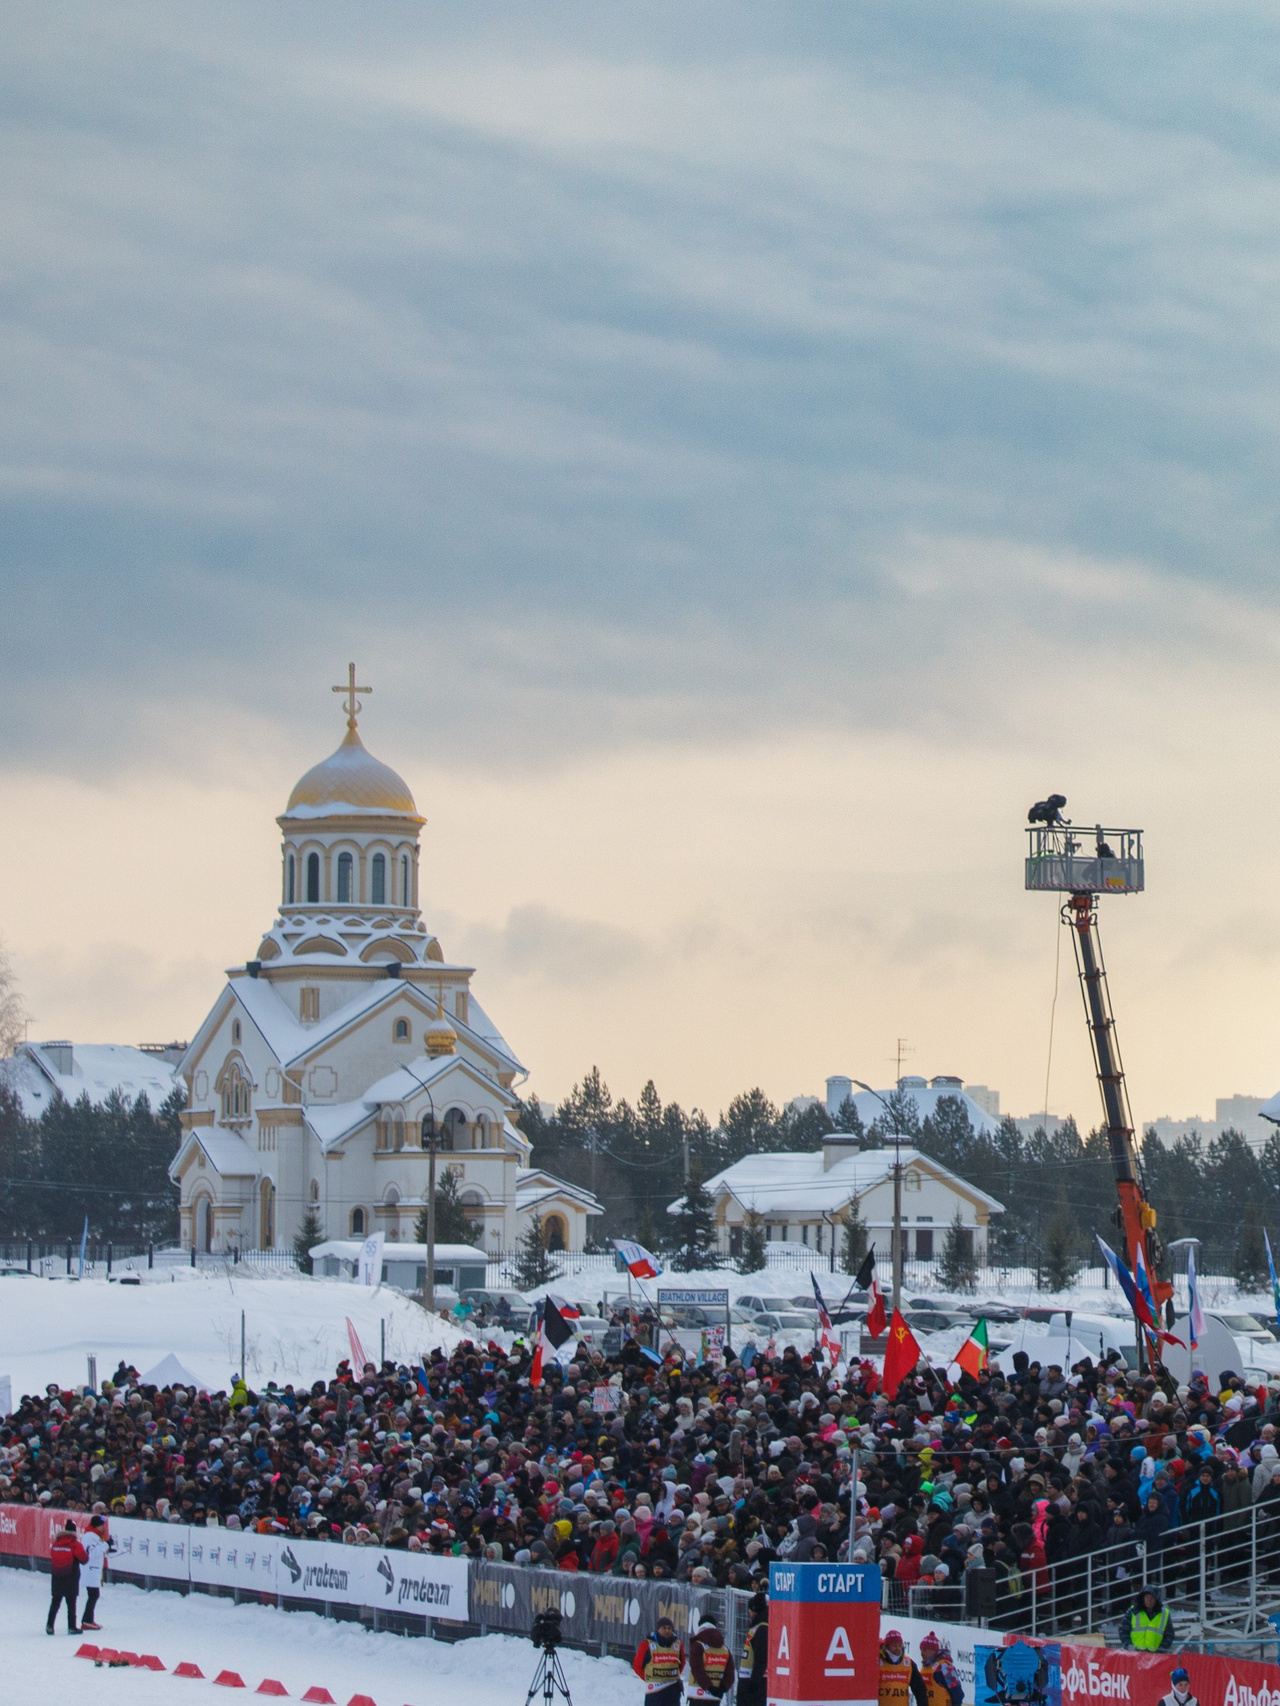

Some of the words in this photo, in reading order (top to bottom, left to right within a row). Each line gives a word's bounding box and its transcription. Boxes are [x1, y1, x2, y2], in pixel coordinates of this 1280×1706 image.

[660, 1292, 696, 1302] BIATHLON
[697, 1292, 726, 1302] VILLAGE
[303, 1562, 350, 1591] proteam
[775, 1572, 795, 1592] СТАРТ
[817, 1573, 865, 1593] СТАРТ
[398, 1575, 451, 1606] proteam
[1088, 1662, 1131, 1700] Банк
